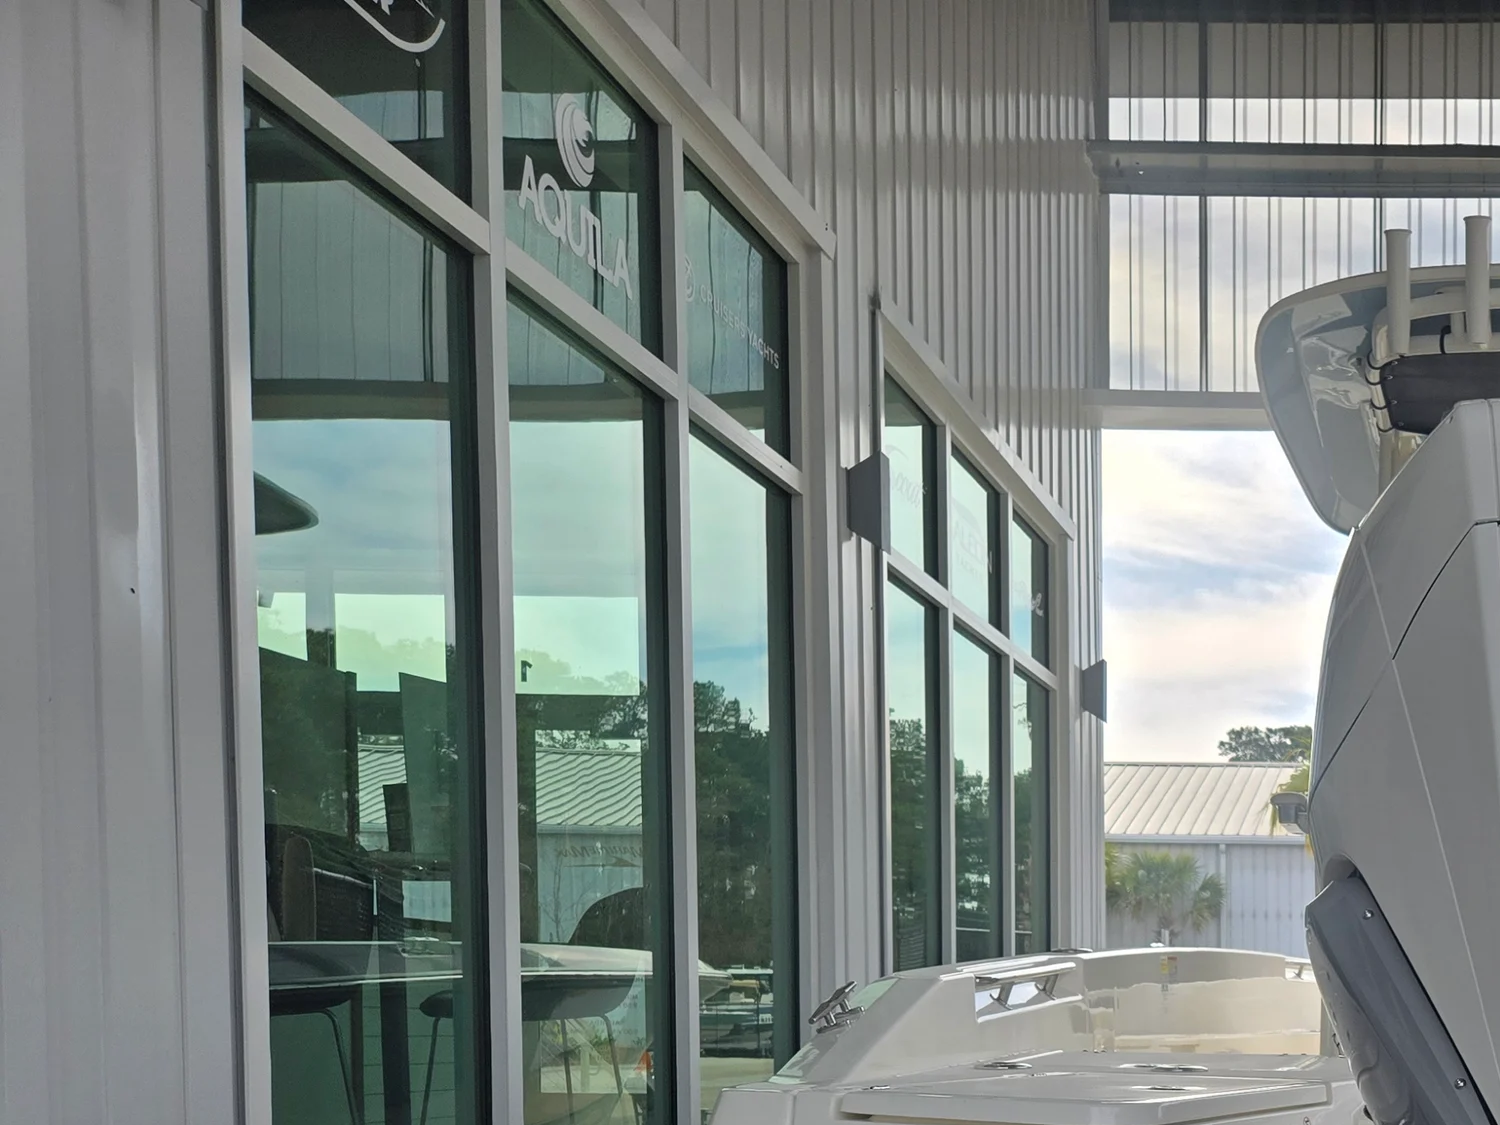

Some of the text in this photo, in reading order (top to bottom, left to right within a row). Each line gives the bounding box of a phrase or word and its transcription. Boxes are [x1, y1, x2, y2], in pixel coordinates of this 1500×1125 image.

[518, 154, 633, 301] AQUILA
[700, 284, 780, 370] CRUISERS YACHTS
